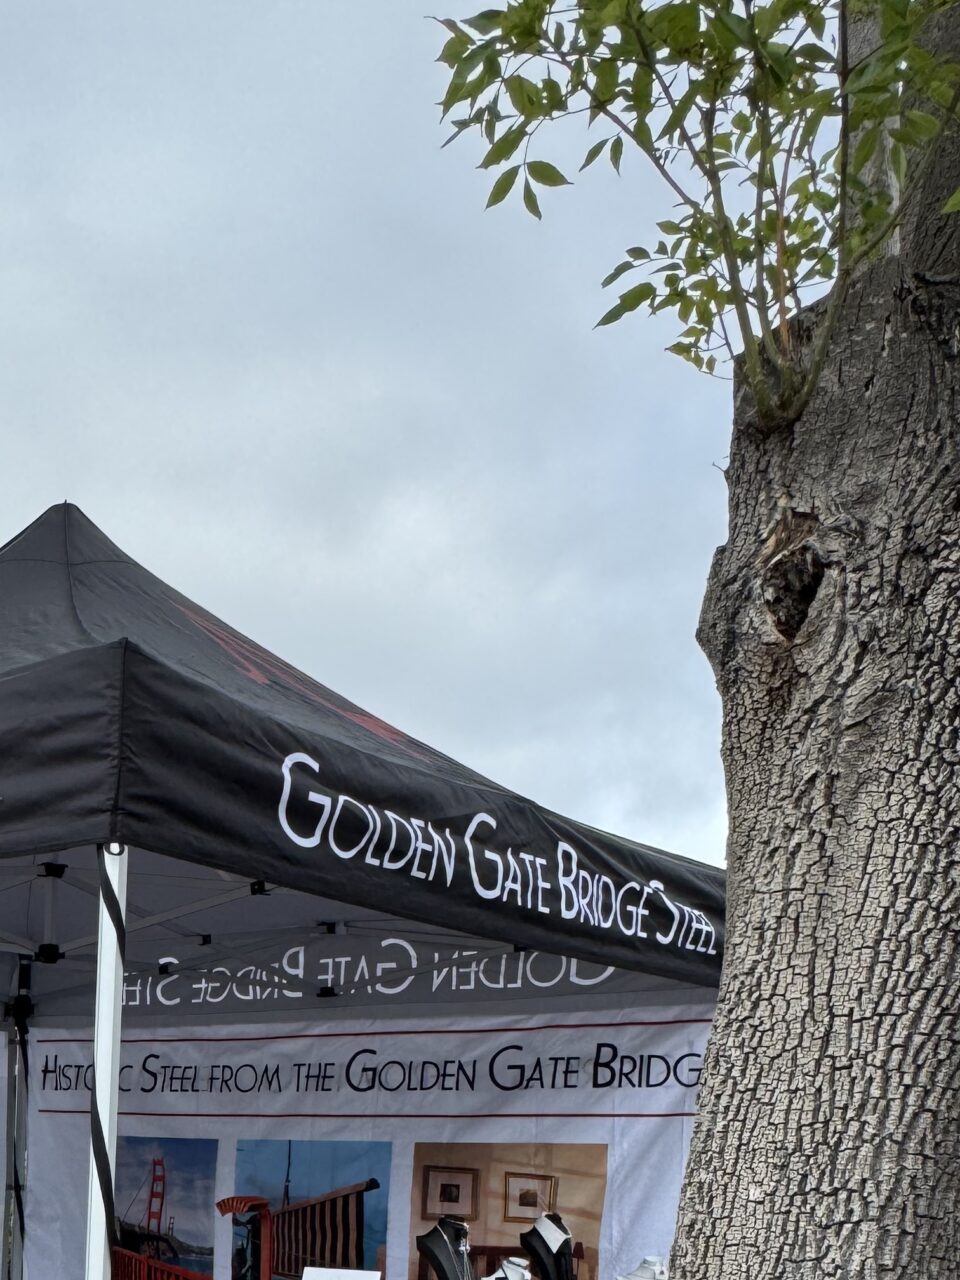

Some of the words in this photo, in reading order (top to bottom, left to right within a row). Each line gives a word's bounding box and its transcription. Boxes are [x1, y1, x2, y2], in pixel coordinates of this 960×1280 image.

[278, 752, 456, 888] GOLDEN
[464, 812, 551, 914] GATE
[557, 841, 653, 938] BRIDGE
[649, 879, 717, 955] STEEL
[140, 1053, 201, 1093] STEEL
[208, 1063, 282, 1093] FROM
[293, 1062, 336, 1092] THE
[345, 1048, 478, 1092] GOLDEN
[488, 1044, 581, 1091] GATE
